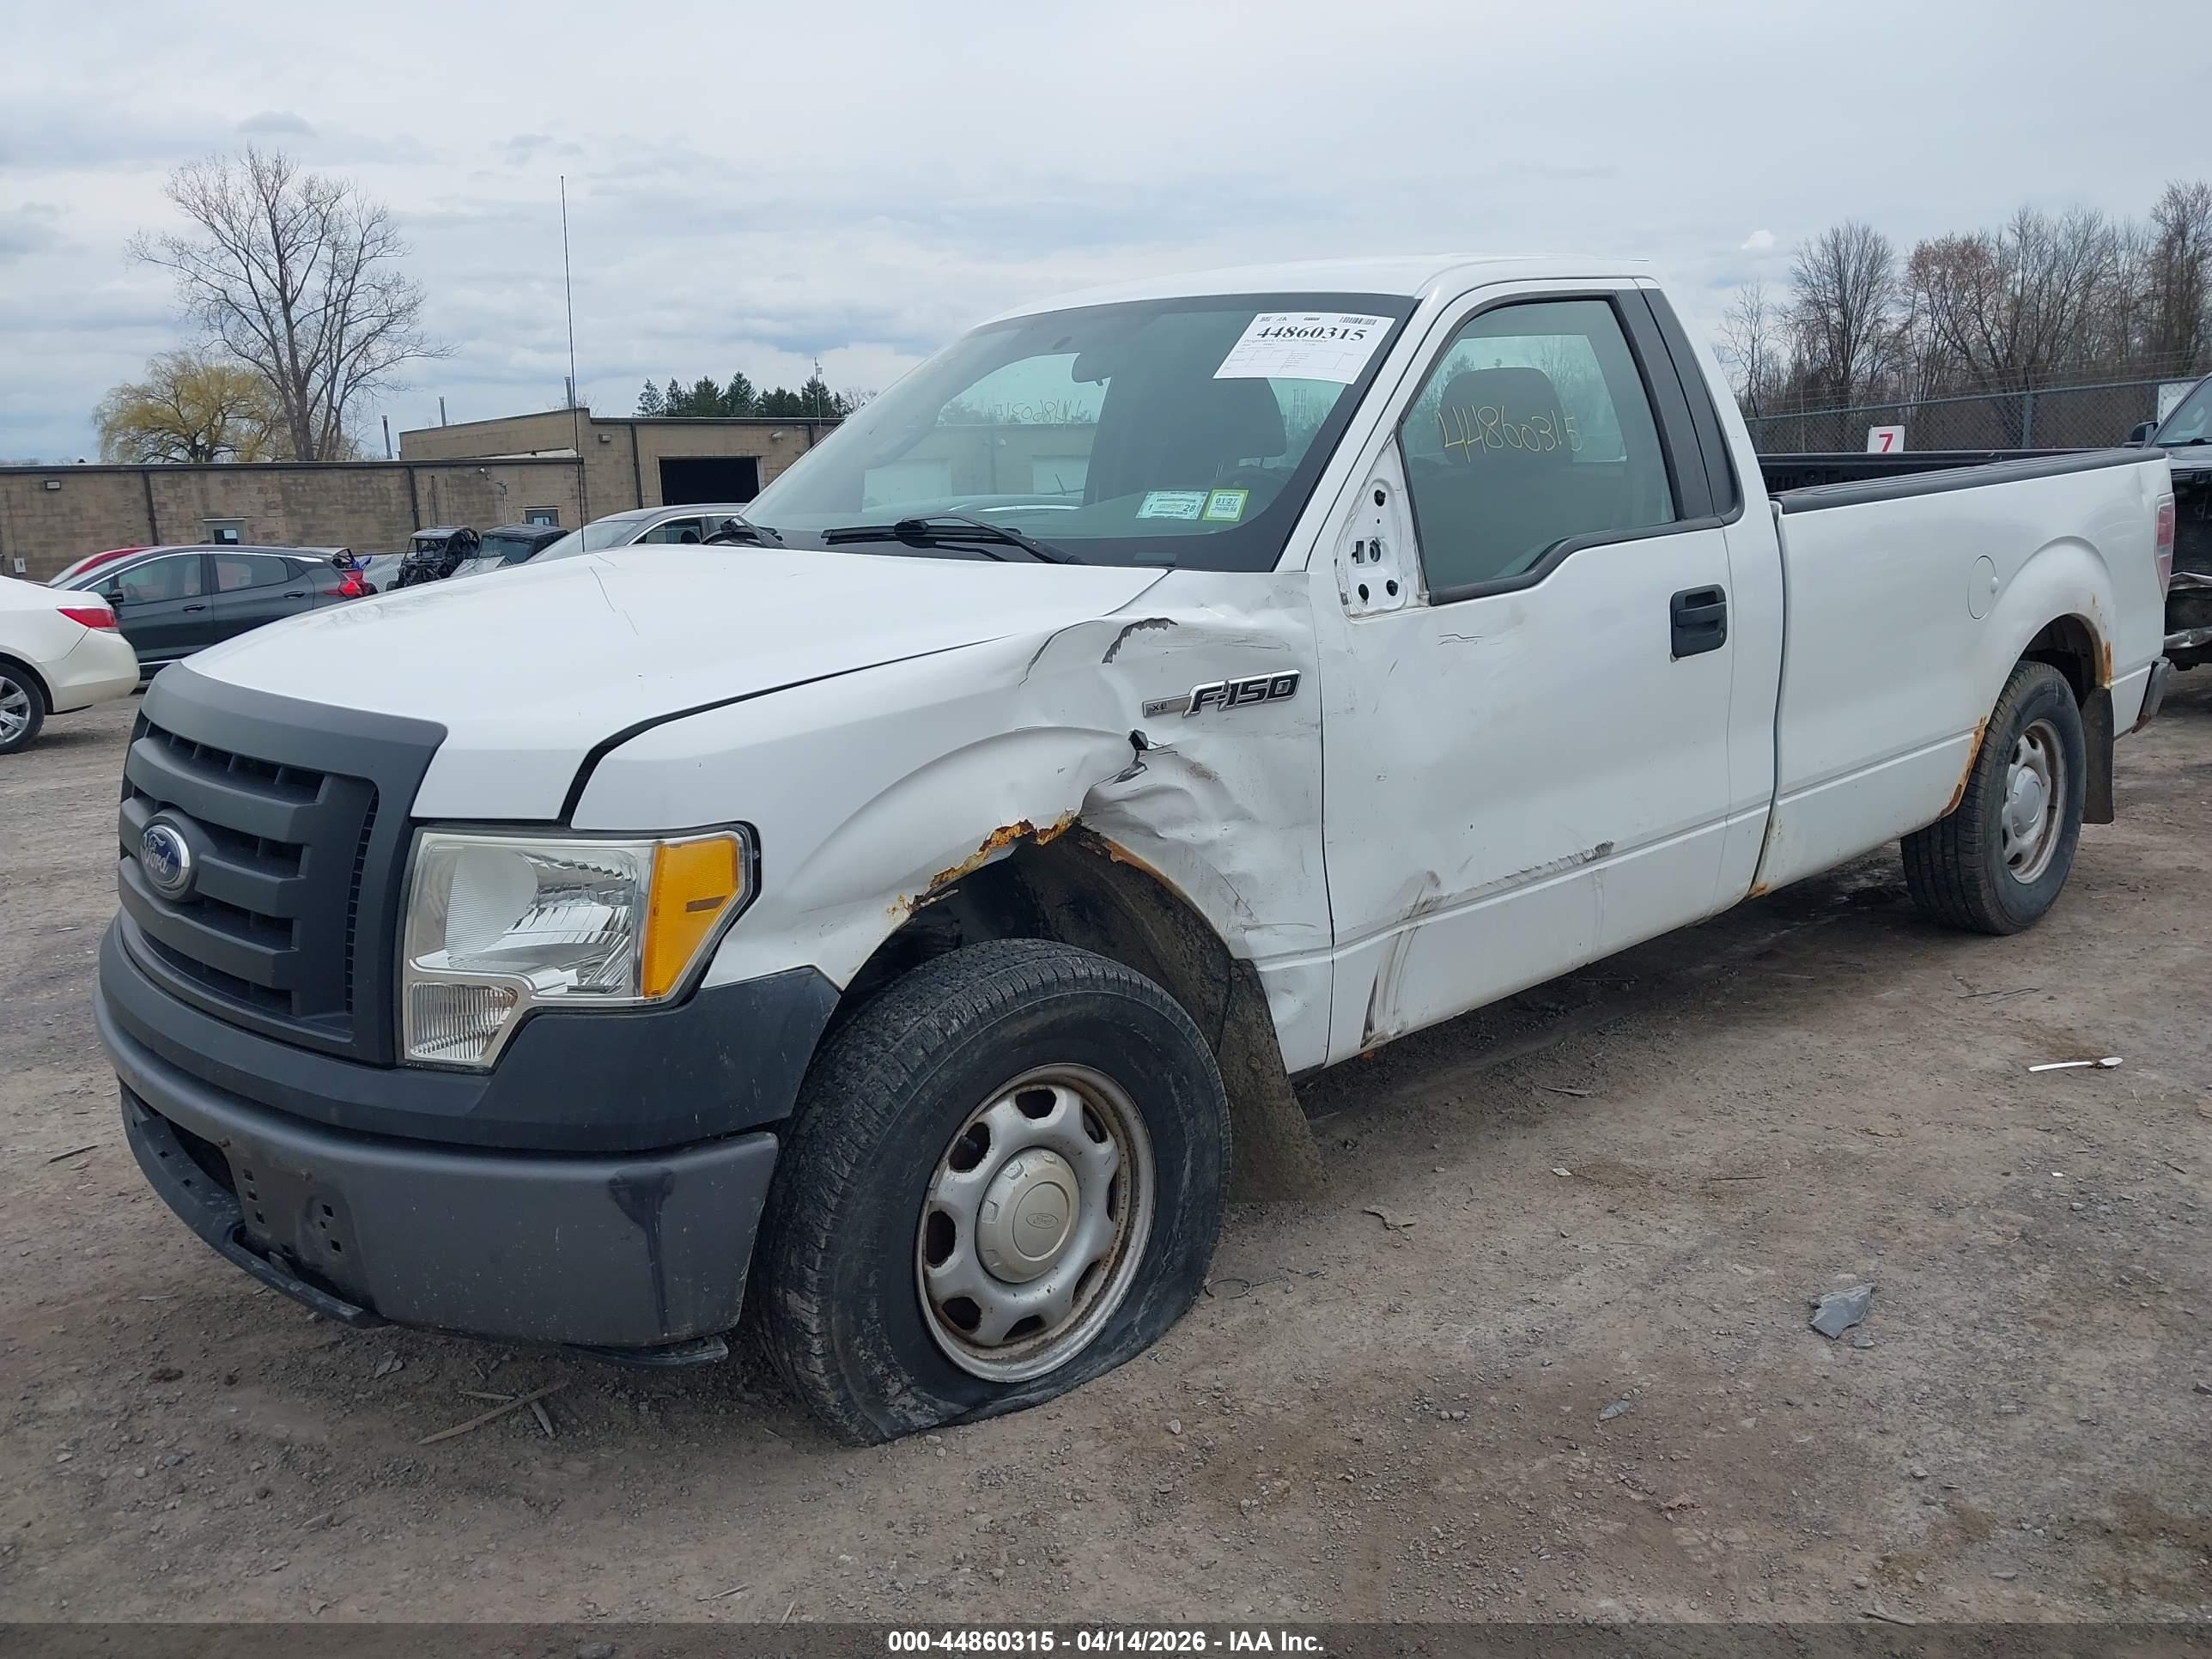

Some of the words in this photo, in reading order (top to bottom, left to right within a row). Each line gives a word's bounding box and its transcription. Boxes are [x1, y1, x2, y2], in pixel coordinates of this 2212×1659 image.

[1256, 325, 1367, 341] 44860315
[1437, 404, 1582, 463] 44860315
[1878, 433, 1893, 453] 7
[1182, 504, 1196, 513] 28
[1182, 669, 1301, 718] F-150
[143, 832, 171, 874] Ford
